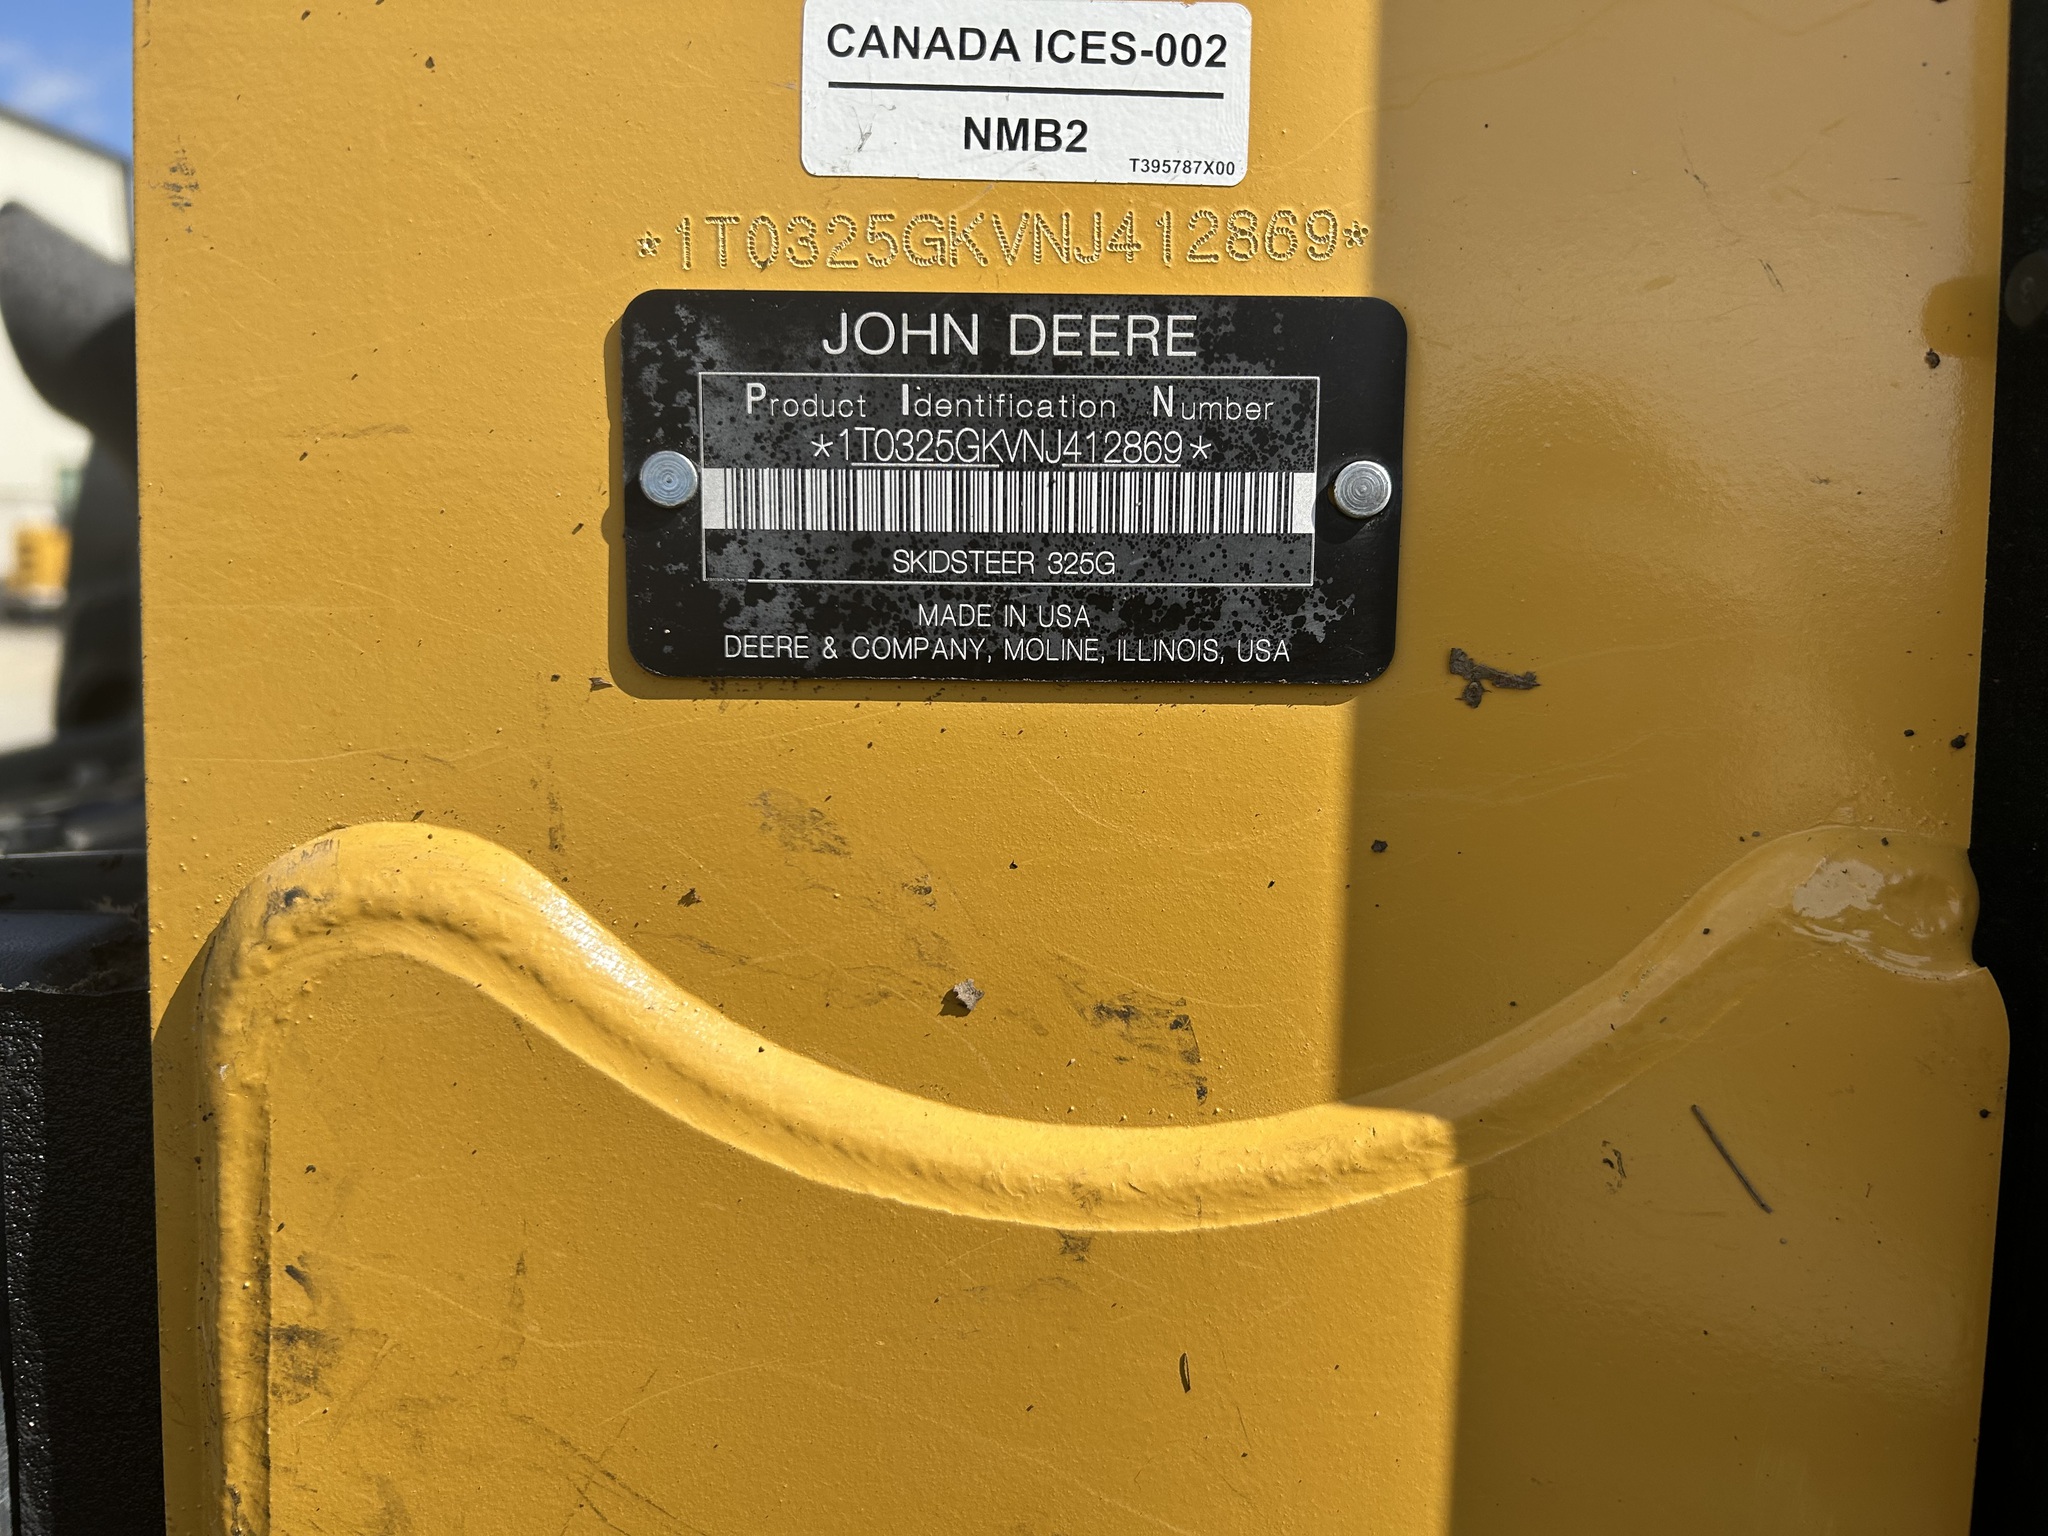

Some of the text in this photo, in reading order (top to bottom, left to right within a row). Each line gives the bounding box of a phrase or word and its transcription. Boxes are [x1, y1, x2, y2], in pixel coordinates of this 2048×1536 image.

[827, 23, 1227, 68] CANADA ICES-002
[964, 116, 1089, 153] NMB2
[1129, 157, 1236, 177] T395787X00
[822, 311, 1198, 357] JOHN DEERE
[746, 382, 1274, 421] Product Identification Number
[893, 548, 1116, 576] SKIDSTEER 325G
[918, 603, 1091, 629] MADE IN USA
[724, 634, 1290, 665] DEERE & COMPANY, MOLINE, ILLINOIS, USA
